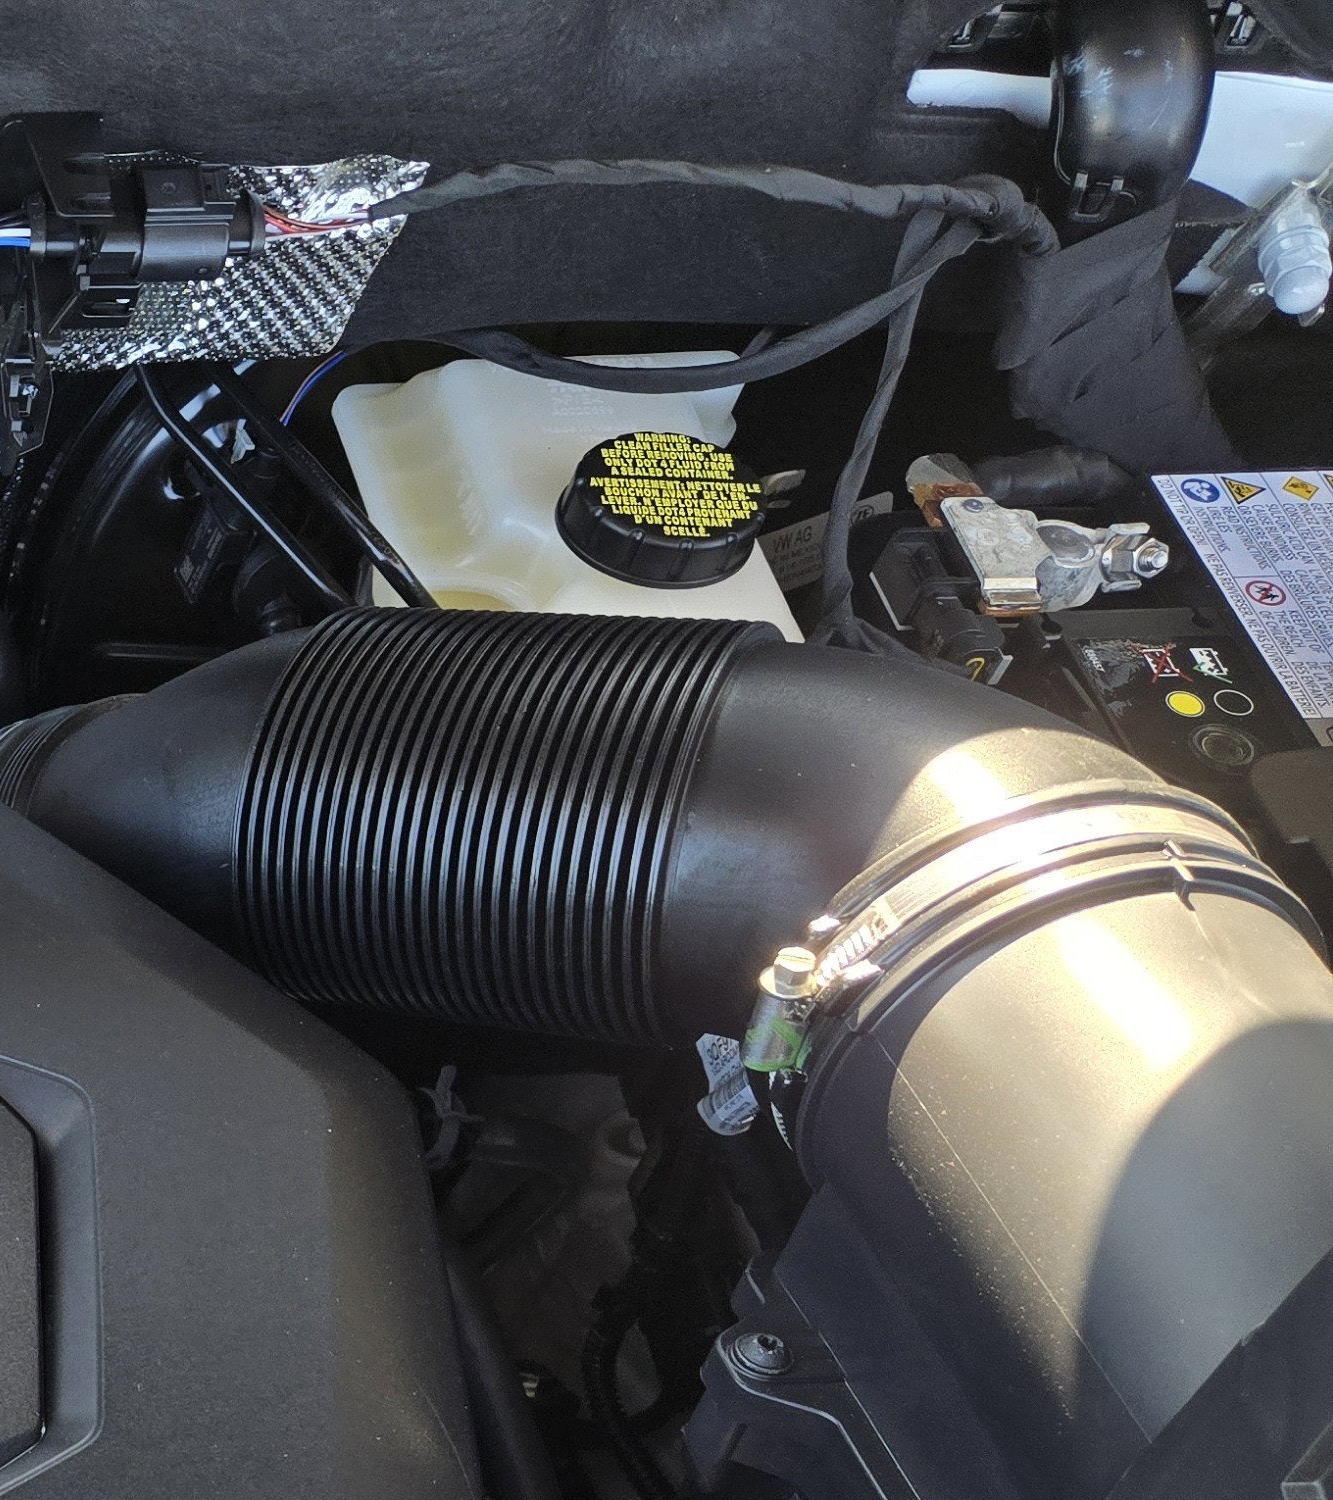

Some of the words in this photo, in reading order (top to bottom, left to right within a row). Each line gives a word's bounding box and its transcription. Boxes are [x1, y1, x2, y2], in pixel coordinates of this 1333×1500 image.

[634, 432, 691, 443] WARNING:
[614, 440, 651, 450] CLEAN
[652, 442, 692, 451] FILLER
[693, 443, 715, 452] CAP
[601, 448, 645, 458] BEFORE
[646, 450, 709, 461] REMOVING.
[710, 452, 733, 462] USE
[604, 458, 633, 467] ONLY
[636, 458, 658, 467] DOT
[660, 459, 668, 468] 4
[669, 460, 702, 469] FLUID
[703, 461, 735, 471] FROM
[611, 466, 619, 476] A
[620, 467, 663, 477] SEALED
[665, 468, 734, 480] CONTAINER.
[590, 477, 685, 490] AVERTISSEMENT:
[686, 481, 745, 492] NETTOYER
[746, 483, 761, 493] LE
[604, 487, 660, 498] BOUCHON
[662, 489, 698, 499] AVANT
[703, 490, 719, 500] DE
[1163, 490, 1183, 502] NOT
[601, 495, 642, 505] LEVER.
[716, 500, 740, 509] QUE
[741, 500, 758, 510] DU
[612, 505, 656, 515] LIQUIDE
[687, 508, 750, 519] PROVENANT
[1204, 506, 1225, 520] LIRE
[1219, 506, 1241, 523] READ
[1236, 505, 1253, 515] OR
[634, 514, 662, 524] D'UN
[664, 516, 732, 528] CONTENANT
[1178, 515, 1197, 524] OR
[1214, 522, 1233, 532] LES
[1243, 516, 1269, 539] SEVERE
[1250, 505, 1274, 525] CAUSE
[1265, 526, 1297, 560] BLINDNESS
[1265, 503, 1294, 533] SULFURIC
[1286, 536, 1305, 550] ACID
[1296, 551, 1315, 564] CAN
[795, 526, 812, 542] AG
[1203, 553, 1220, 562] NE
[1209, 564, 1229, 576] PAS
[1279, 570, 1297, 582] DES
[1311, 595, 1327, 604] LA
[1257, 610, 1275, 619] OF
[1272, 610, 1292, 623] THE
[1286, 610, 1309, 627] KEEP
[1243, 618, 1261, 627] NE
[1250, 630, 1270, 641] PAS
[1264, 621, 1298, 656] CHILDREN.
[1281, 625, 1306, 647] REACH
[1298, 628, 1318, 642] OUT
[1307, 644, 1325, 653] OF
[1259, 643, 1288, 668] OUVRIR
[1290, 661, 1310, 674] DES
[1304, 661, 1321, 670] DE
[1311, 672, 1329, 681] LA
